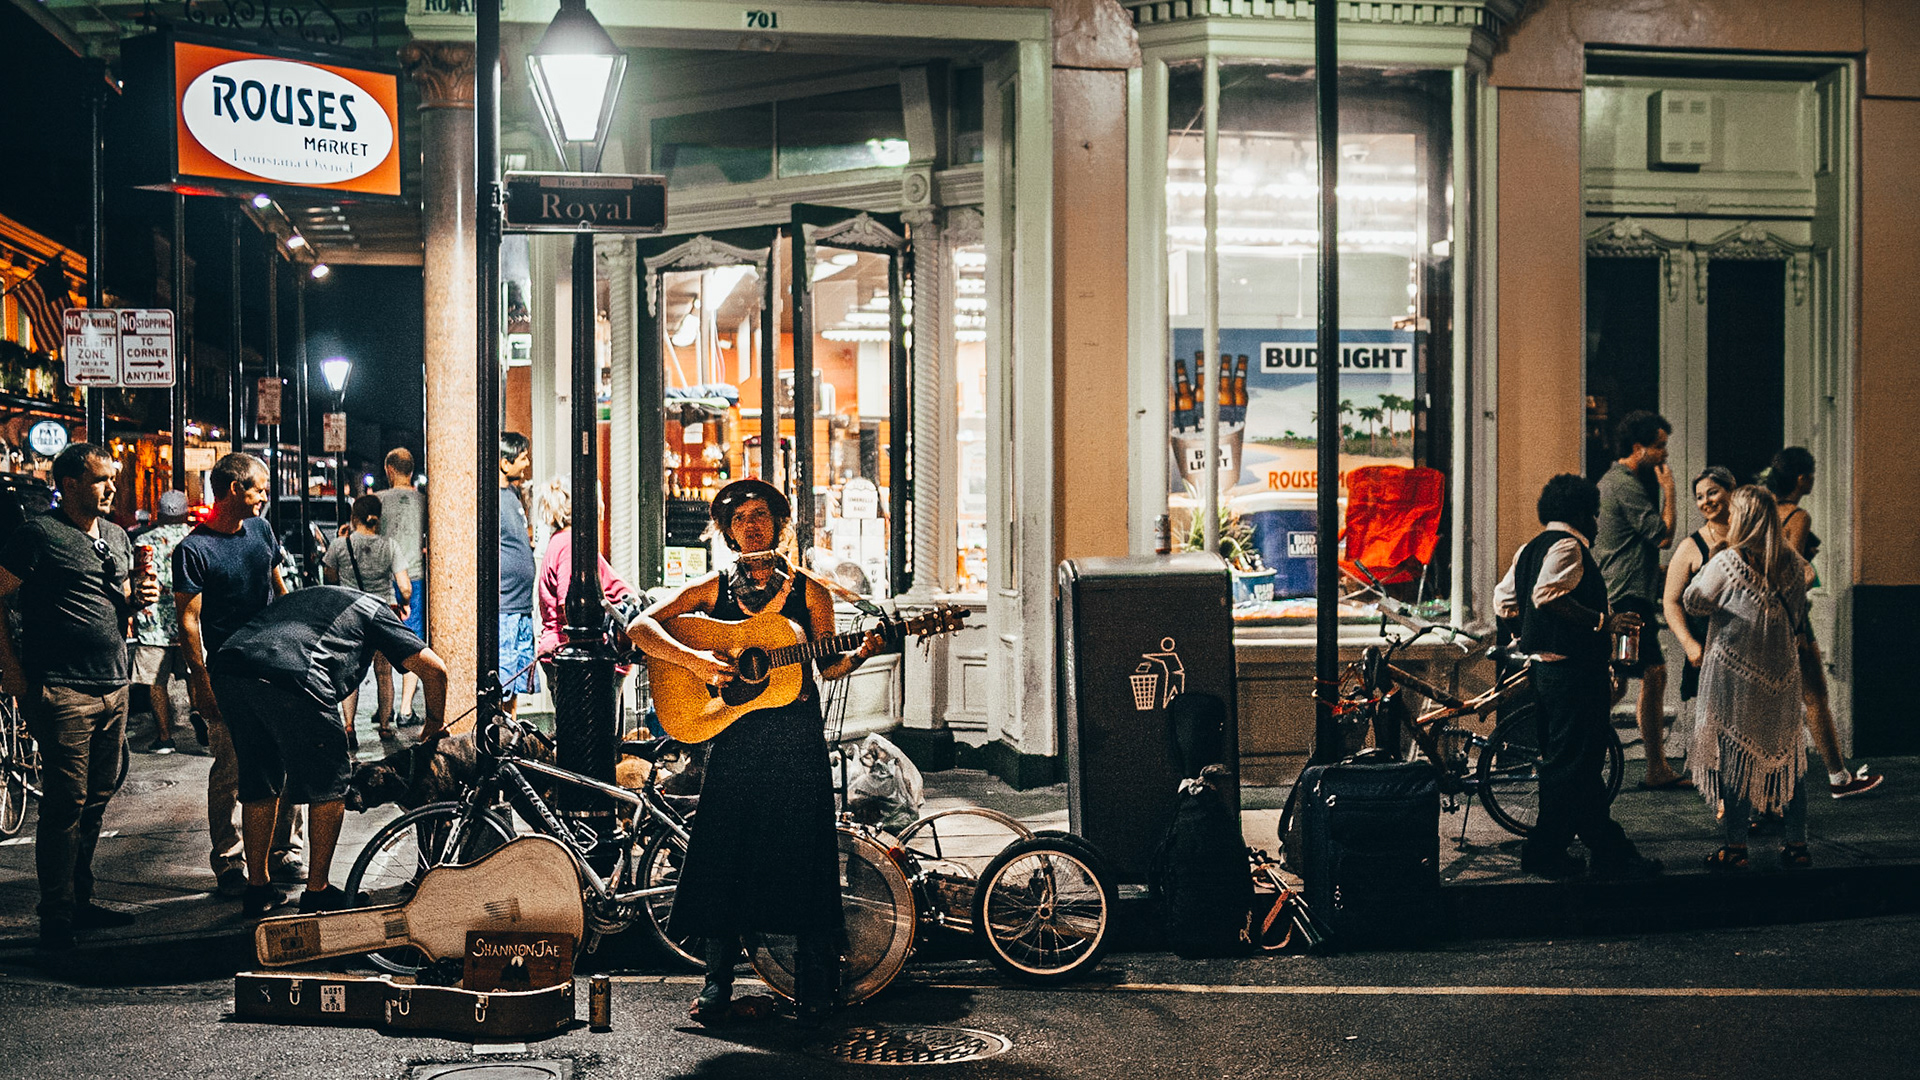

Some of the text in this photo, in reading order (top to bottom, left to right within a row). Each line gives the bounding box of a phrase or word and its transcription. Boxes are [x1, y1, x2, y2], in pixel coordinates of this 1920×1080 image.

[747, 10, 778, 28] 701
[212, 74, 358, 132] ROUSES
[304, 136, 369, 157] MARKET
[232, 147, 354, 174] Louisiana Owned
[541, 193, 633, 224] Royal
[65, 314, 81, 331] NO
[121, 313, 172, 331] NO STOPPING
[141, 337, 154, 346] TO
[78, 348, 106, 359] ZONE
[126, 348, 169, 358] CORNER
[1337, 347, 1408, 369] IGHT
[126, 371, 171, 381] ANYTIME
[1268, 470, 1319, 490] ROUSE
[1294, 534, 1317, 545] BUD
[1290, 544, 1318, 556] LIGH
